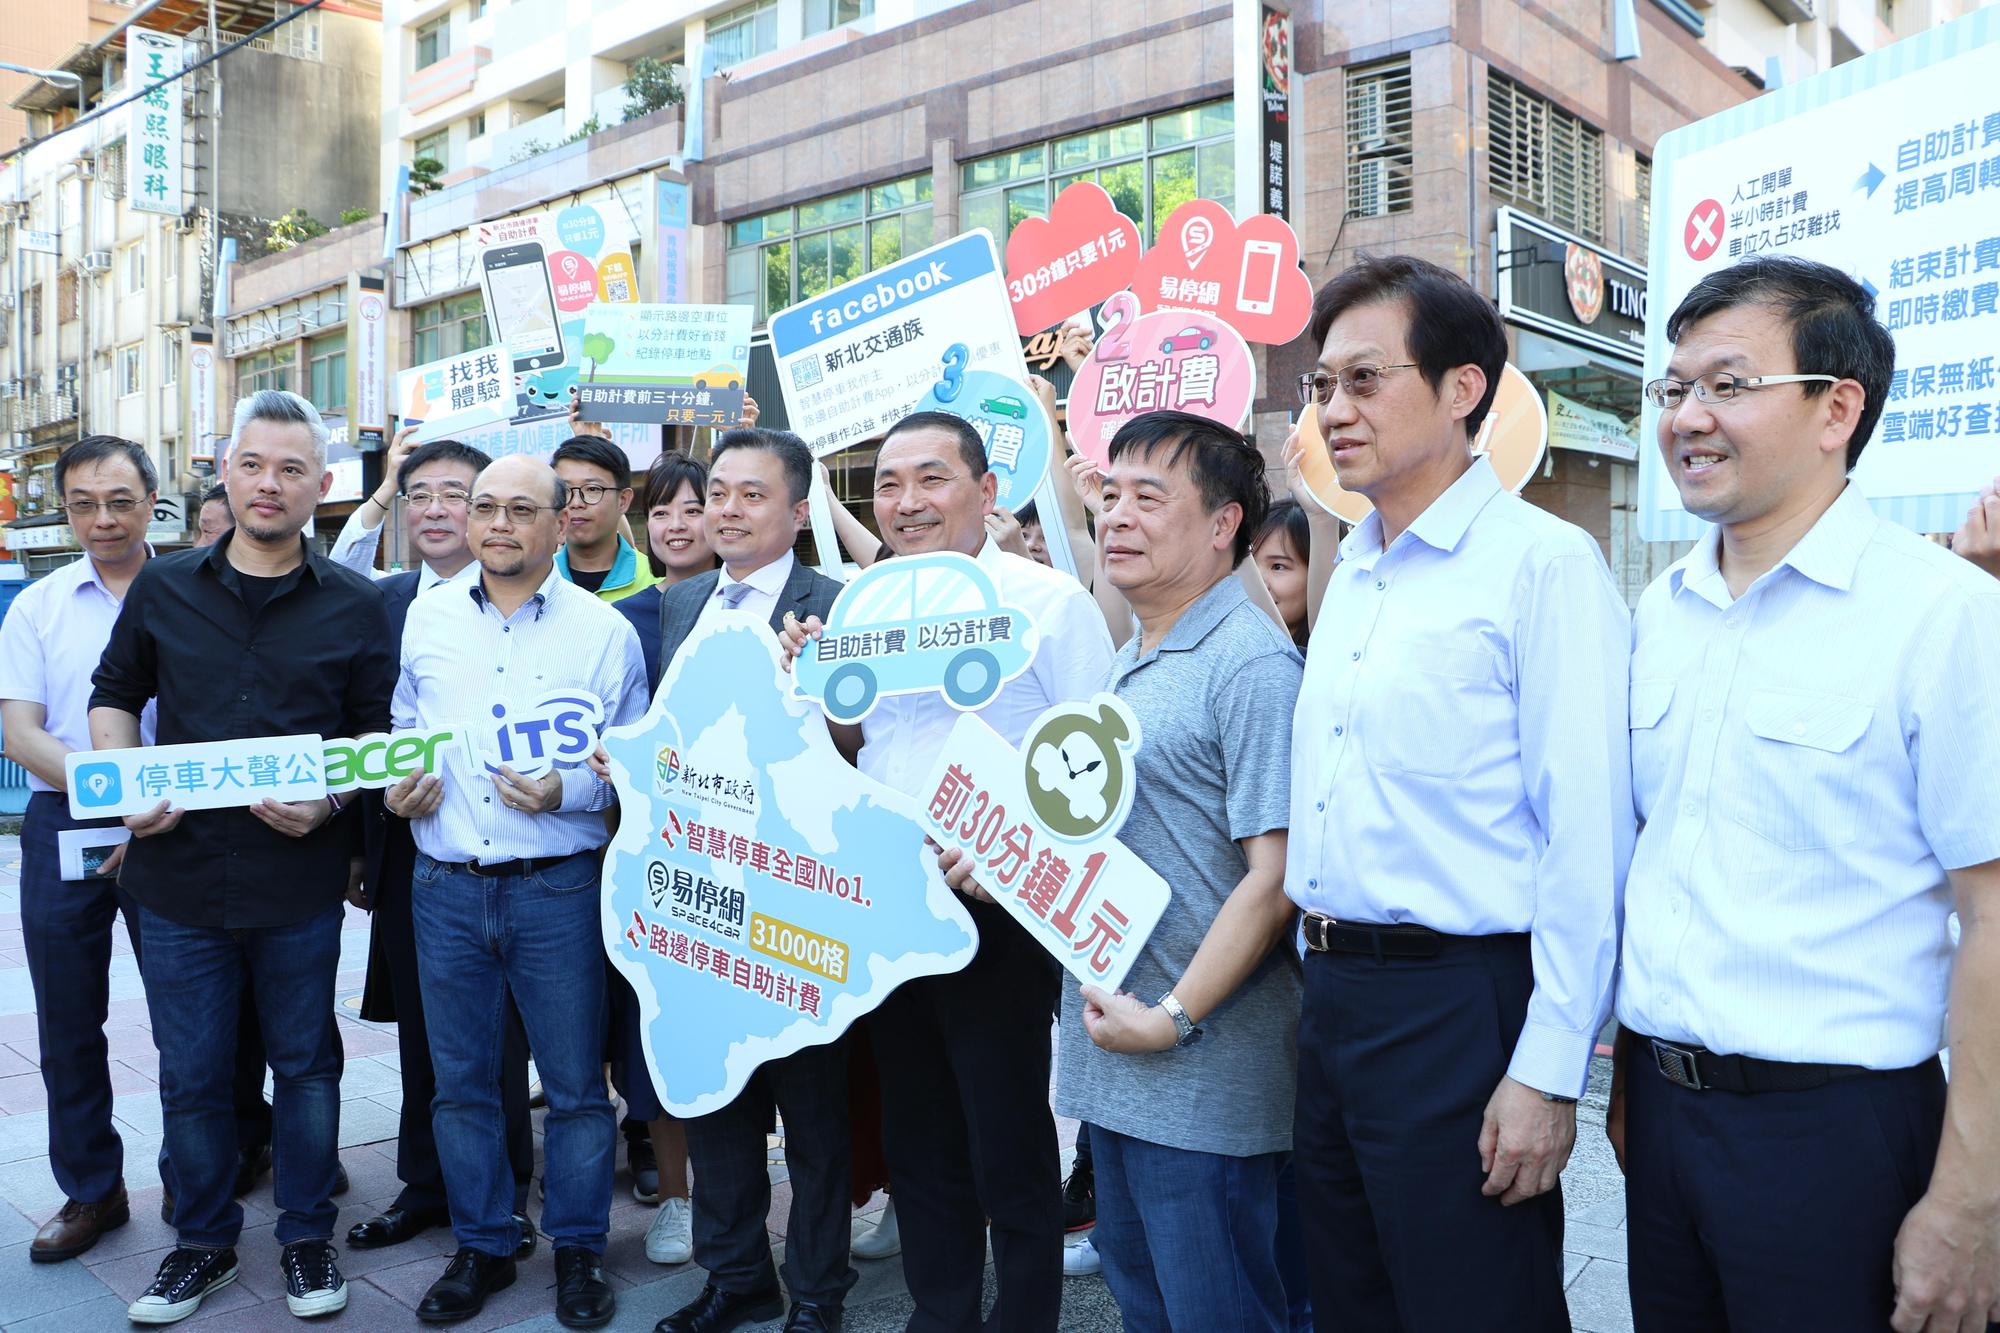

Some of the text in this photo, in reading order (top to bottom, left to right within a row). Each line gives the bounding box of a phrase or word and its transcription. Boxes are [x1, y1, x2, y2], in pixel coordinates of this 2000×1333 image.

[1896, 110, 2000, 173] 自助計費
[1729, 190, 1808, 230] 半小時計費
[1730, 166, 1793, 204] 人工開單
[1728, 208, 1841, 258] 車位久占好難找
[1009, 227, 1126, 303] 30分鐘只要1元
[1889, 235, 2000, 290] 結束計費
[809, 260, 953, 335] facebook
[1159, 276, 1220, 305] 易停網
[1887, 281, 1999, 331] 即時繳費
[637, 328, 727, 343] 以分計費好省錢
[640, 309, 728, 325] 顯示路邊空車位
[1095, 294, 1138, 363] 2
[450, 354, 499, 386] 找我
[635, 347, 711, 361] 紀錄停車地點
[824, 317, 925, 373] 新北交通族
[450, 380, 501, 411] 體驗
[933, 343, 970, 403] 3
[1889, 356, 2000, 402] 環保無紙
[817, 616, 1011, 662] 自助計費 以分計費
[135, 752, 318, 798] 停車大聲公
[323, 732, 453, 786] acer
[681, 764, 755, 805] 新北市政府
[693, 793, 710, 802] Taipei
[711, 797, 722, 807] City
[723, 801, 755, 815] Government
[686, 819, 873, 908] 智慧停車全國No1.
[928, 763, 1130, 974] 前30分鐘1元
[671, 868, 746, 926] 易停網
[649, 923, 822, 1018] 路邊停車自助計費
[752, 918, 846, 979] 31000格
